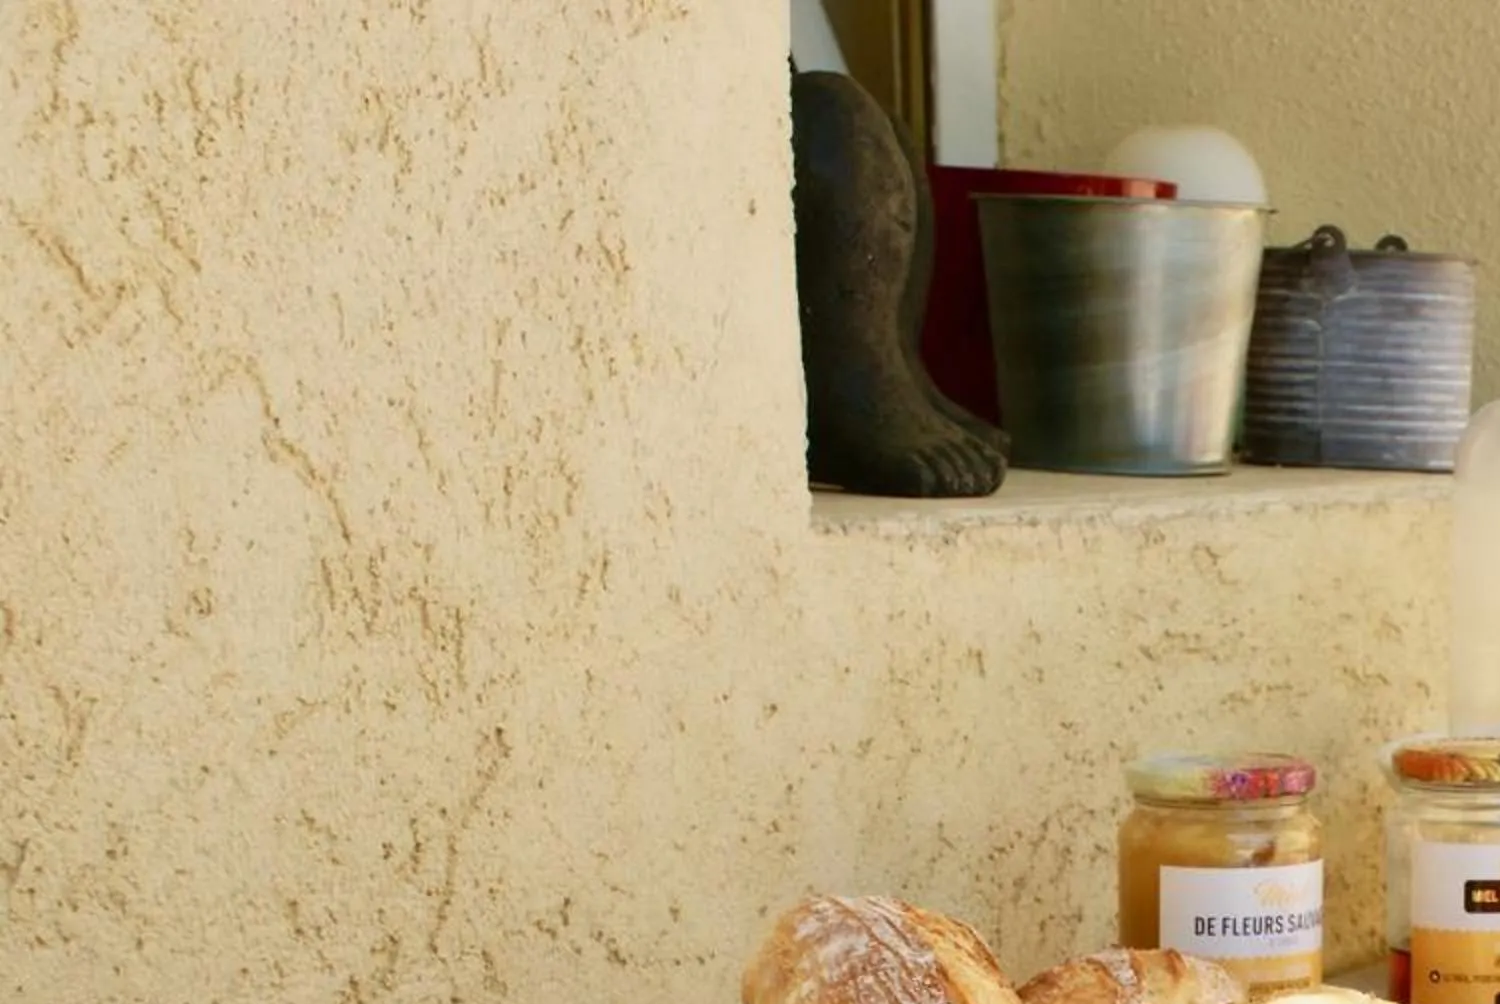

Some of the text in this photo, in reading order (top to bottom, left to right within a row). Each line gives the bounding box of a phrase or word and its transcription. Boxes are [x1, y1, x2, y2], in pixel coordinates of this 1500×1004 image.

[1471, 889, 1498, 903] MIEL
[1194, 916, 1217, 937] DE
[1221, 915, 1284, 937] FLEURS
